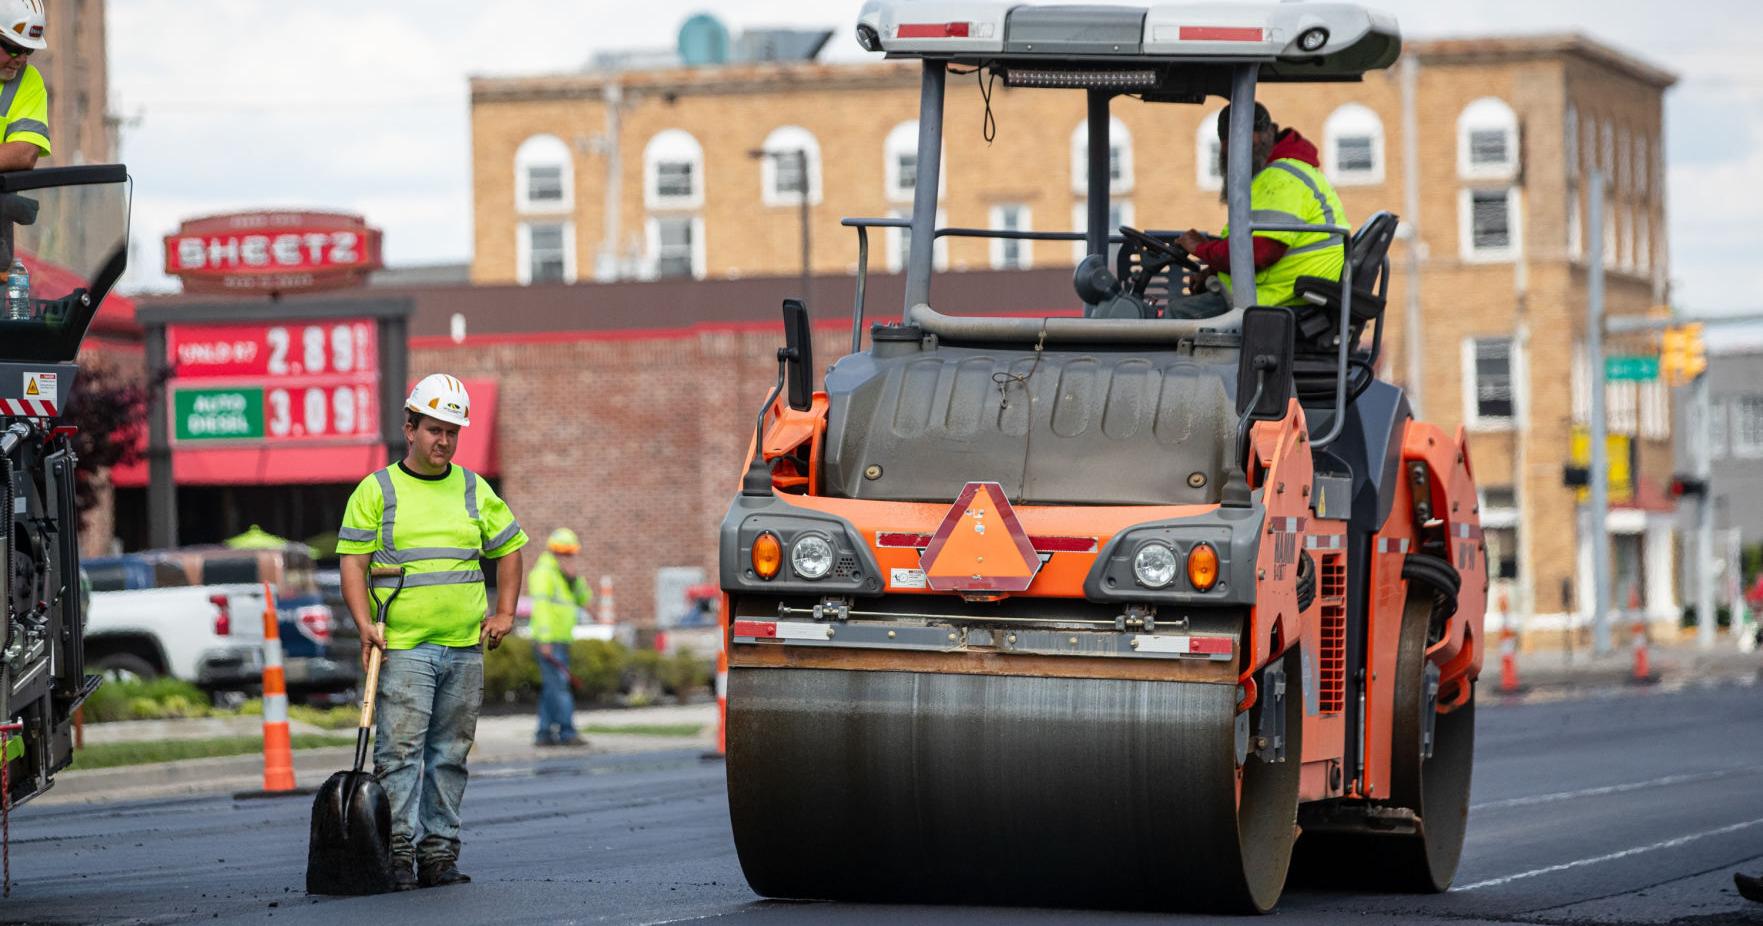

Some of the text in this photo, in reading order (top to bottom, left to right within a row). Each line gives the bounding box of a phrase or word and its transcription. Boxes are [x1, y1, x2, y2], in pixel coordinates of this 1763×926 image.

[177, 231, 359, 269] SHEETZ
[194, 393, 247, 413] AUTO
[187, 413, 249, 434] DIESEL
